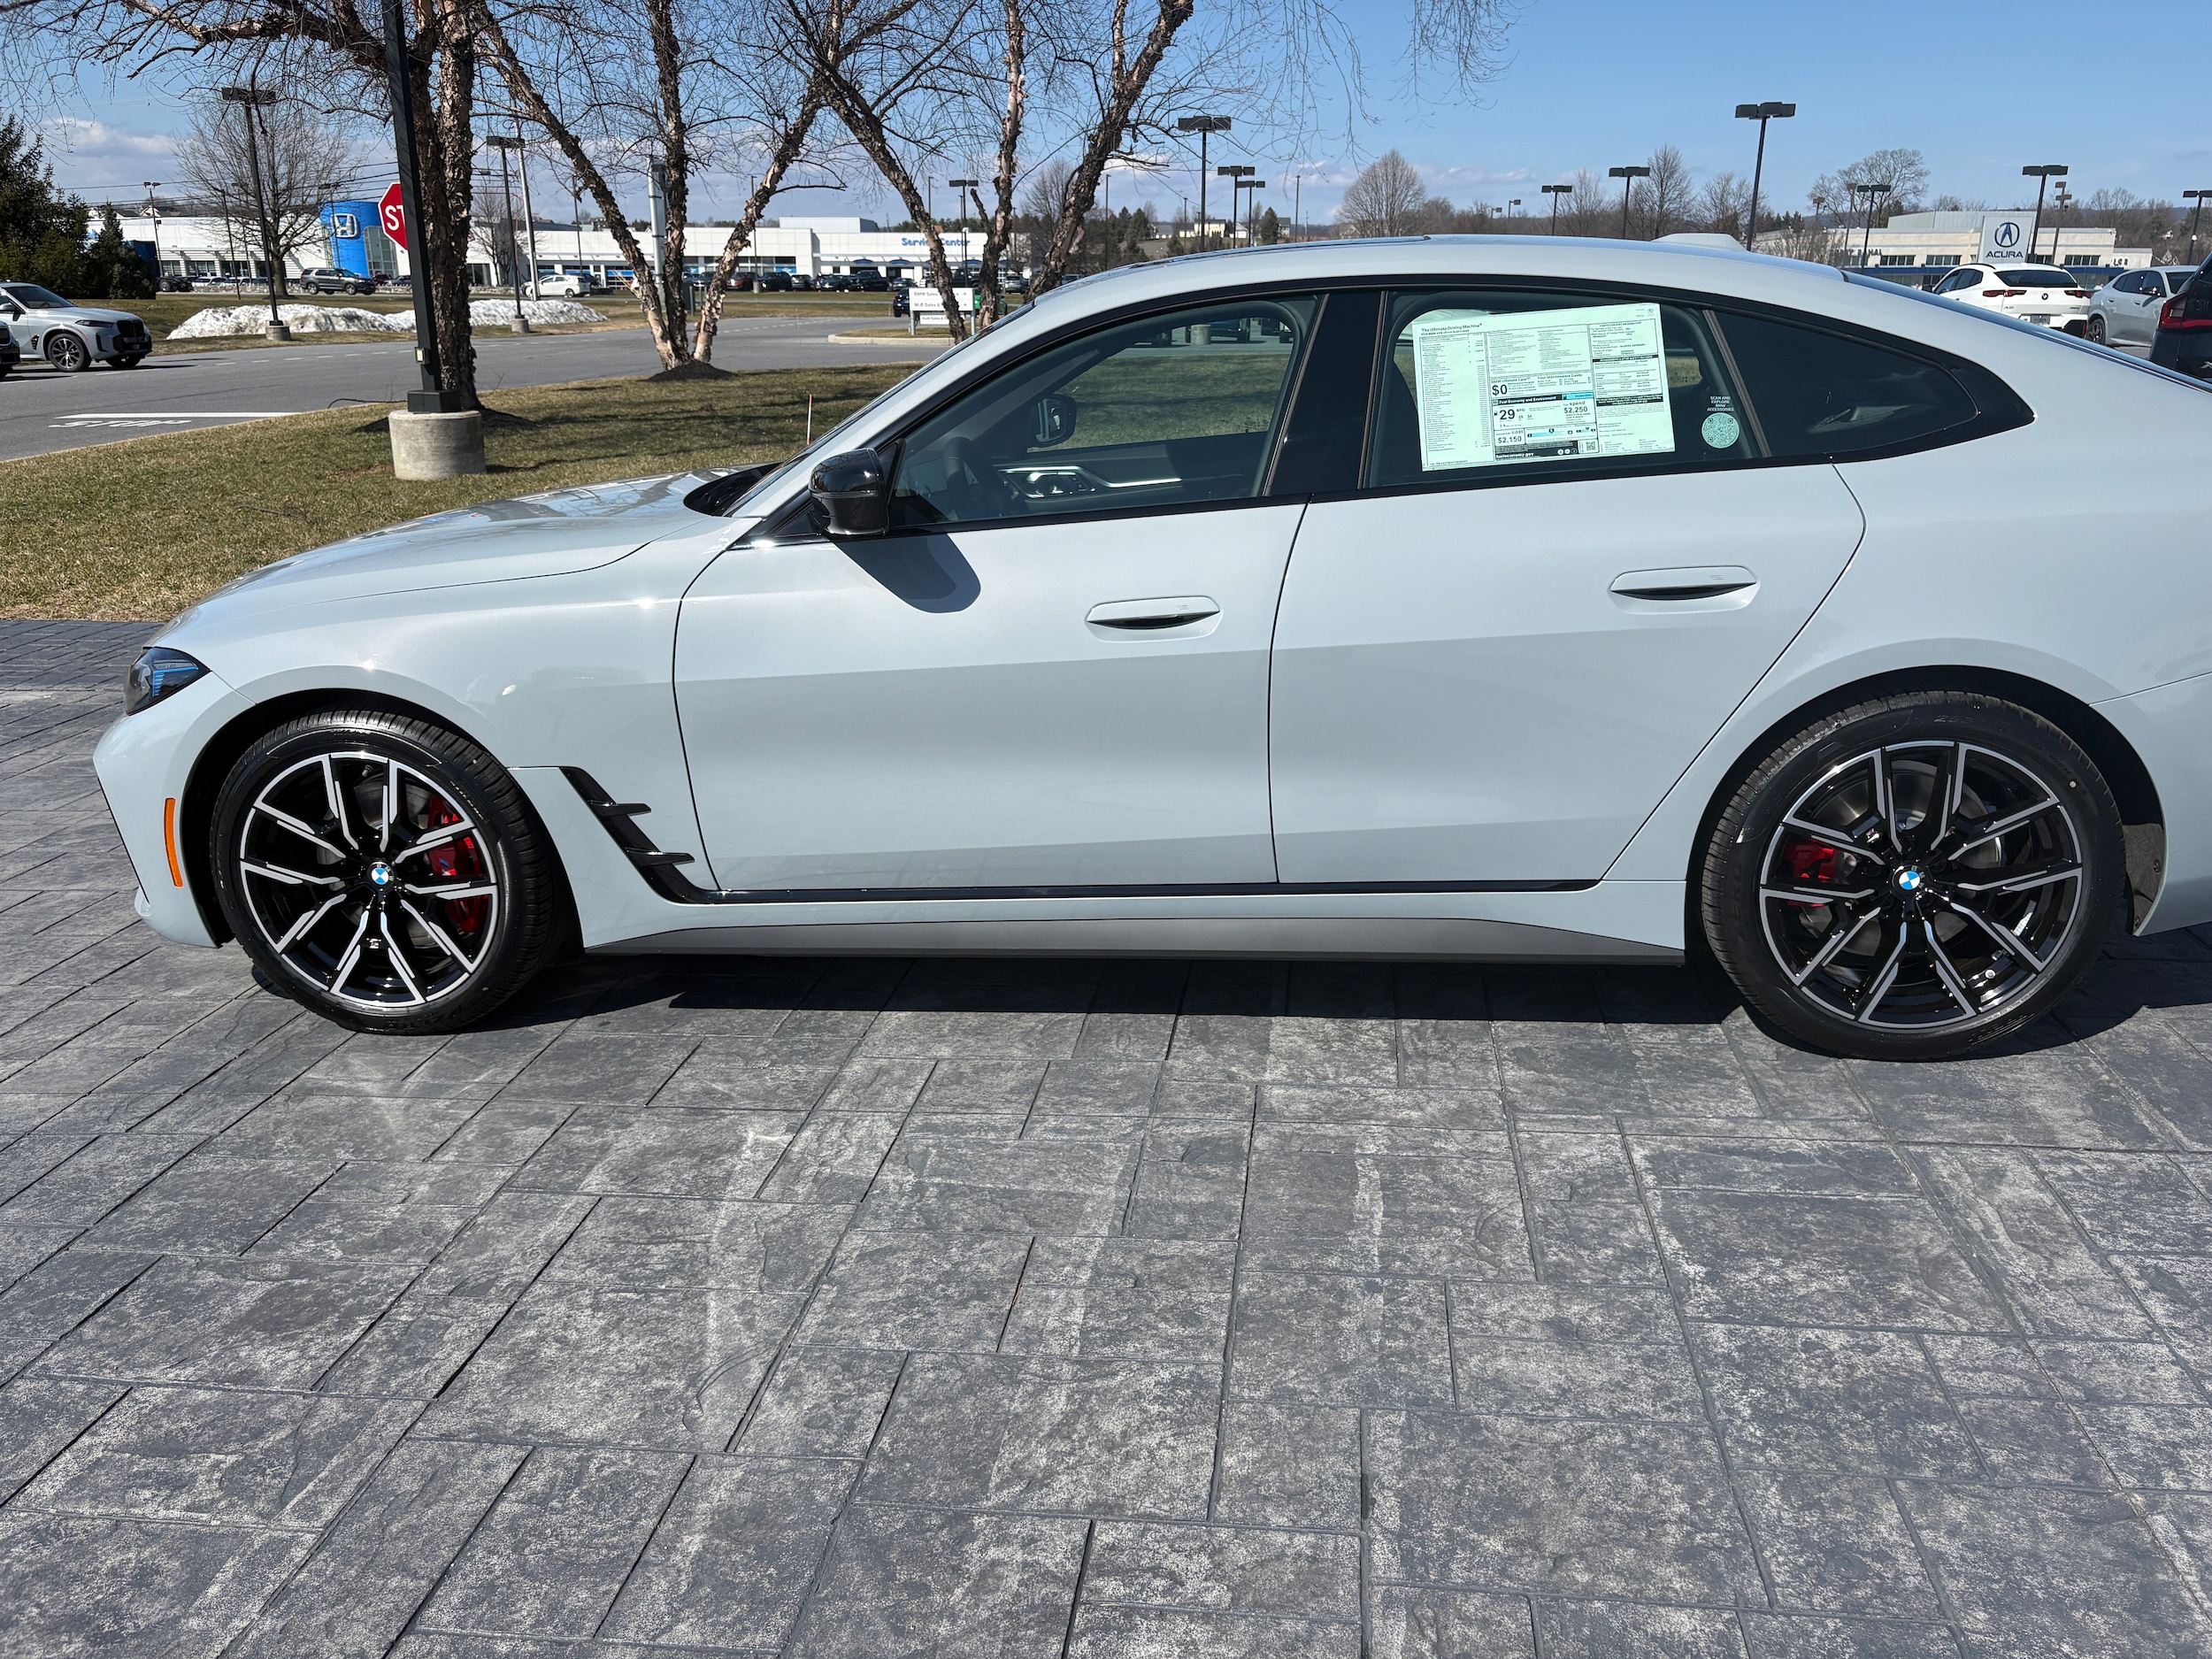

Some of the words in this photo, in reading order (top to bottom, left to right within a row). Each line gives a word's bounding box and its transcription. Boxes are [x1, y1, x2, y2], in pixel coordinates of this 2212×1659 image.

[385, 204, 406, 231] ST
[901, 237, 929, 246] Servic
[1492, 384, 1508, 396] $0
[1499, 409, 1516, 420] 29
[1563, 405, 1588, 414] $2,250
[48, 419, 192, 428] STOP
